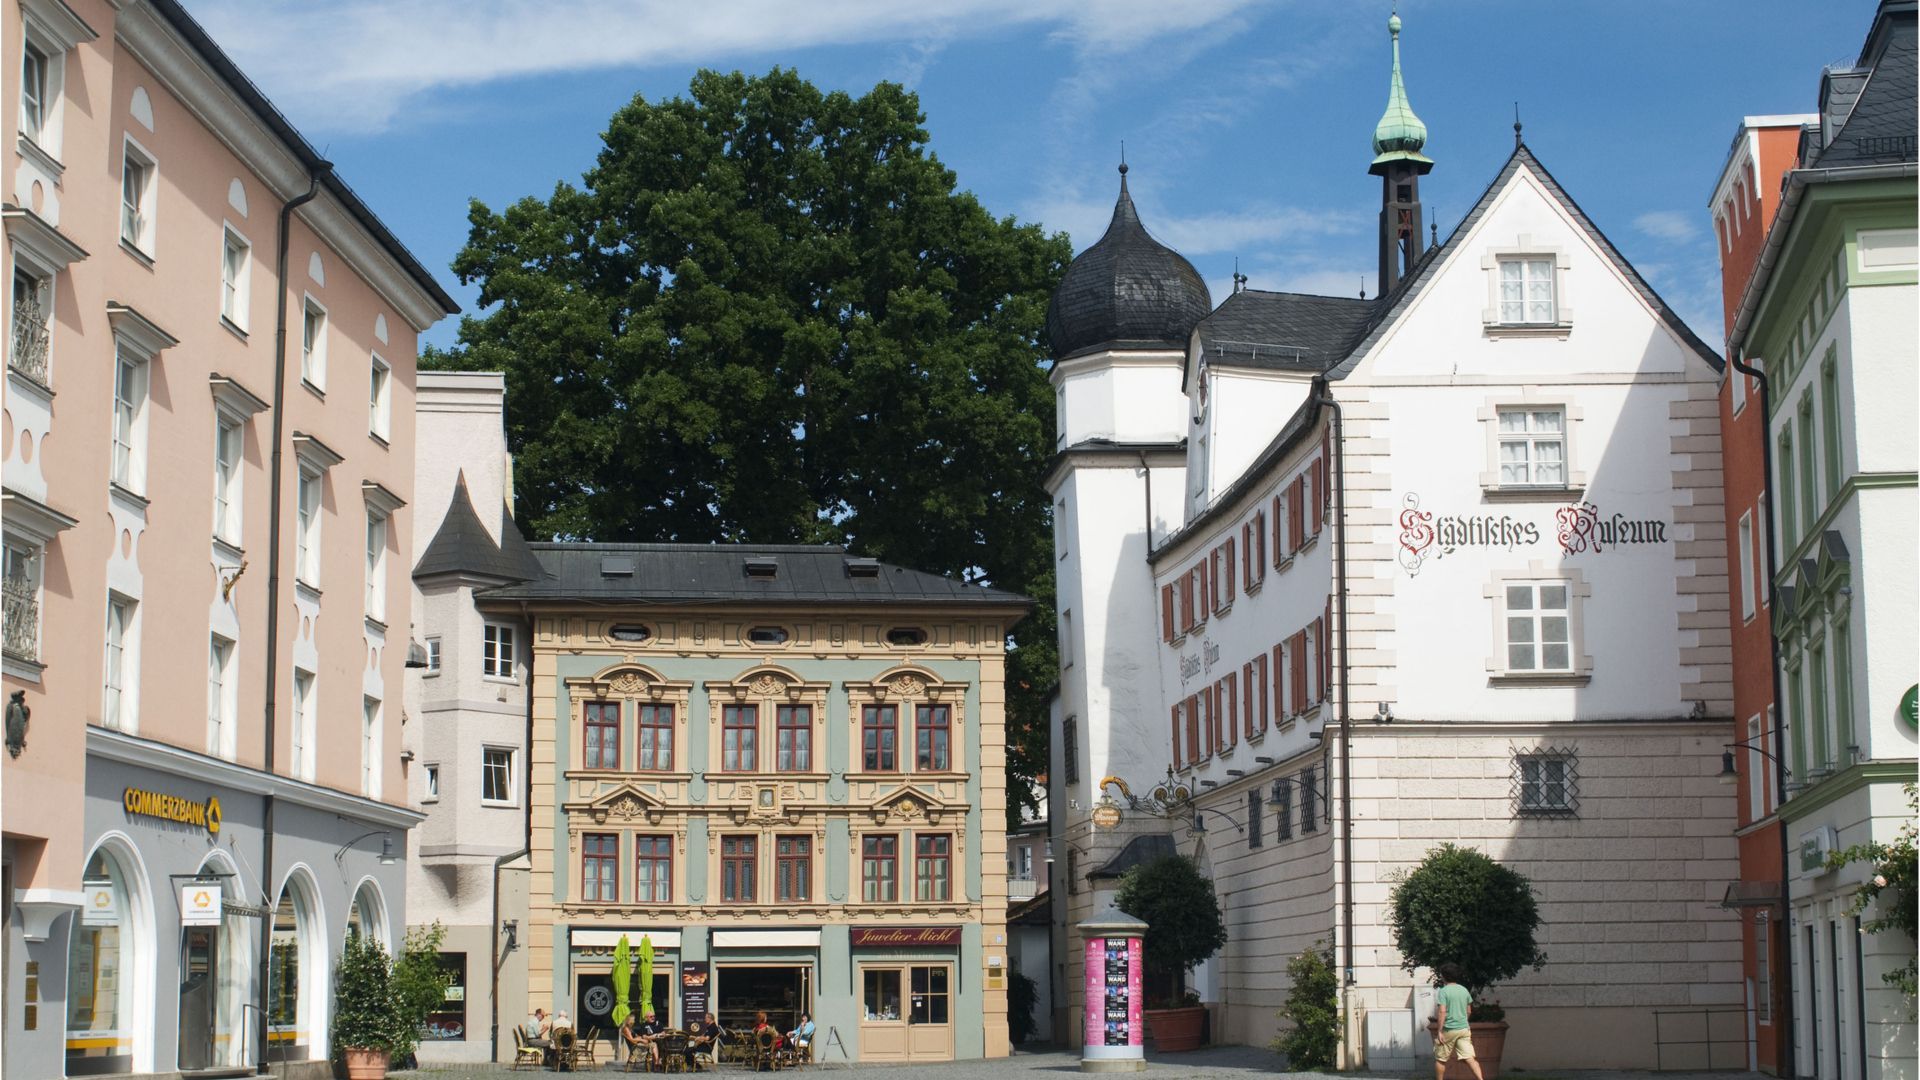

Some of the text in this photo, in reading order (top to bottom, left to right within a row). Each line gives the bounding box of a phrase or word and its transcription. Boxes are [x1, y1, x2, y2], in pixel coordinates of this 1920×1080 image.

[1556, 502, 1667, 556] Museum
[124, 787, 206, 826] COMMERZBANK
[856, 928, 957, 944] Juwelier Michl
